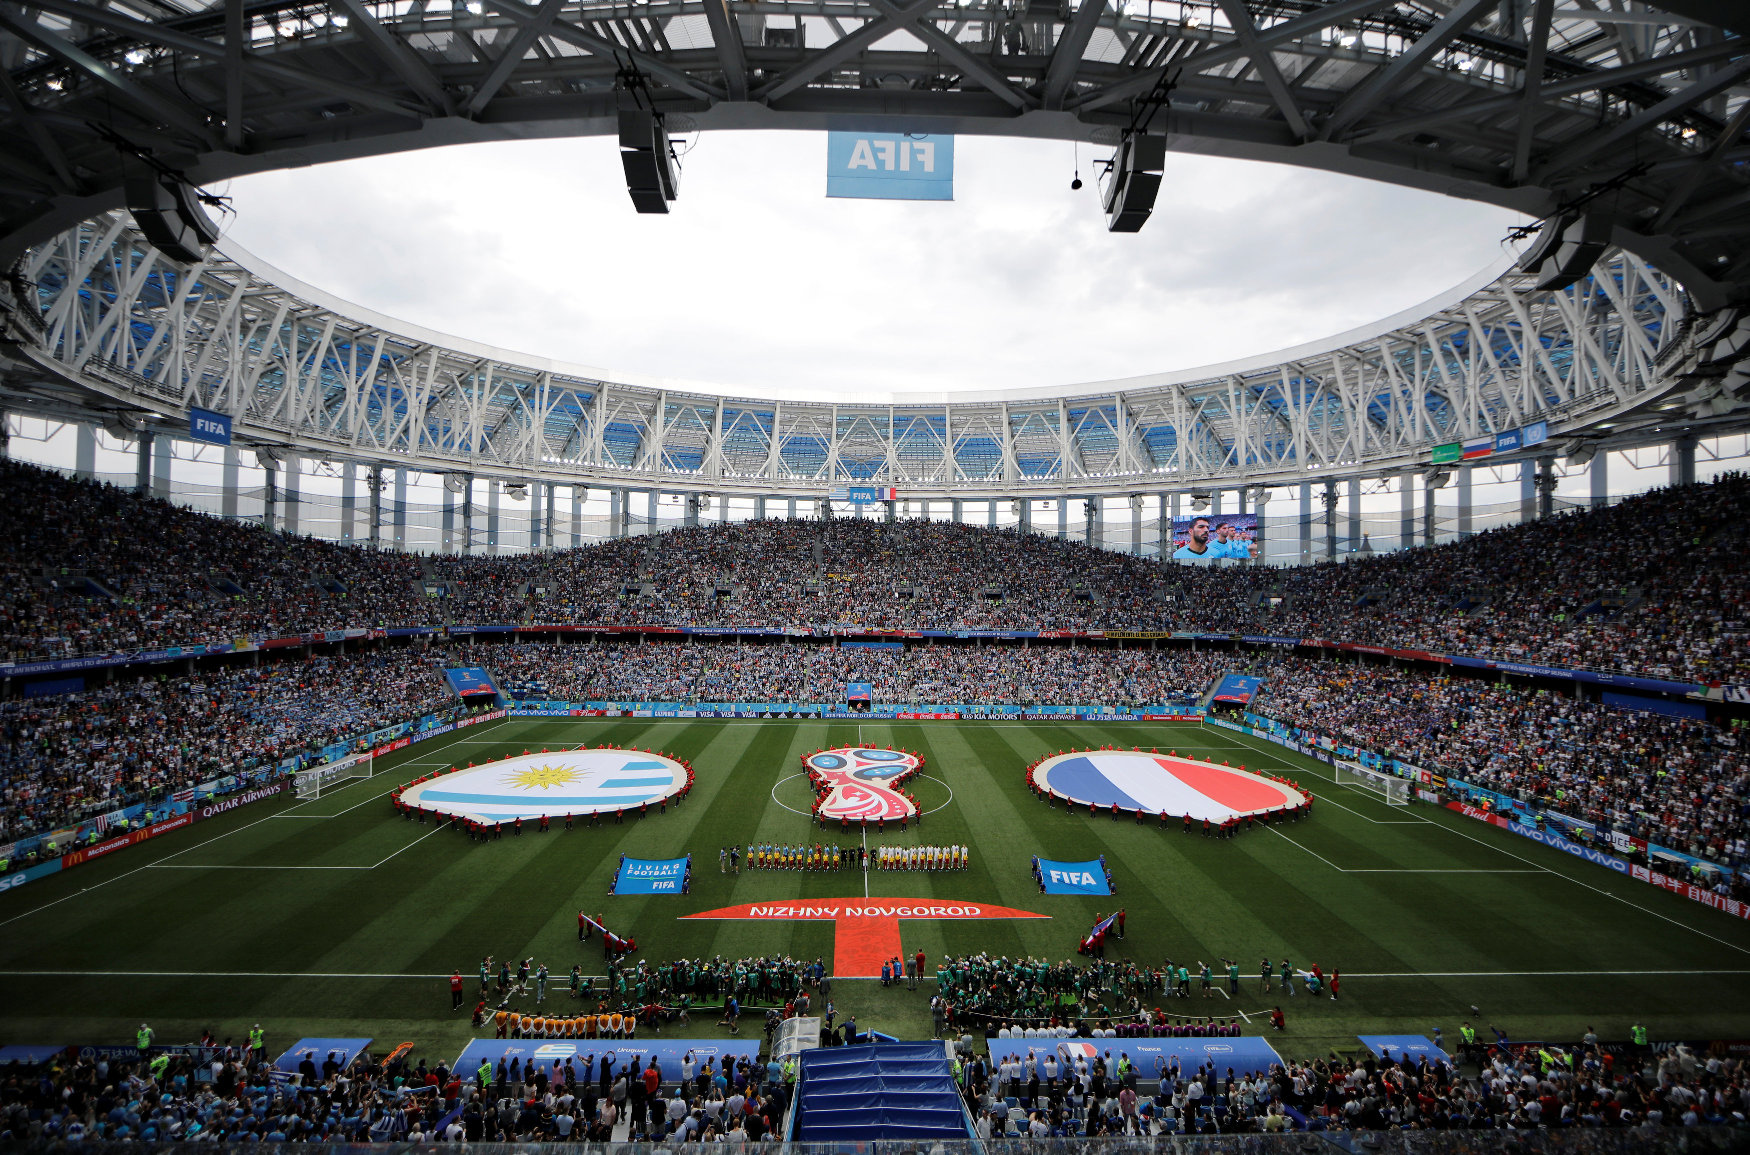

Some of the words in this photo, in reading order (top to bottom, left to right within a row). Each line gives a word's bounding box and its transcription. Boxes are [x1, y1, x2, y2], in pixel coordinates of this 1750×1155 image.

[197, 418, 225, 436] FIFA
[1499, 436, 1517, 447] FIFA
[853, 492, 872, 500] FIFA
[1214, 718, 1243, 732] Hisense
[1300, 746, 1312, 756] VISA
[1316, 751, 1329, 763] VISA
[324, 760, 356, 776] MOTORS
[203, 797, 239, 818] QATAR
[240, 784, 281, 806] AIRWAYS
[1461, 803, 1488, 822] Bud
[152, 818, 188, 834] McDonald's
[88, 838, 130, 856] McDonald's
[652, 880, 675, 889] FIFA
[1050, 870, 1096, 886] FIFA
[750, 906, 839, 916] NIZHNY
[846, 906, 980, 917] NOVGOROD
